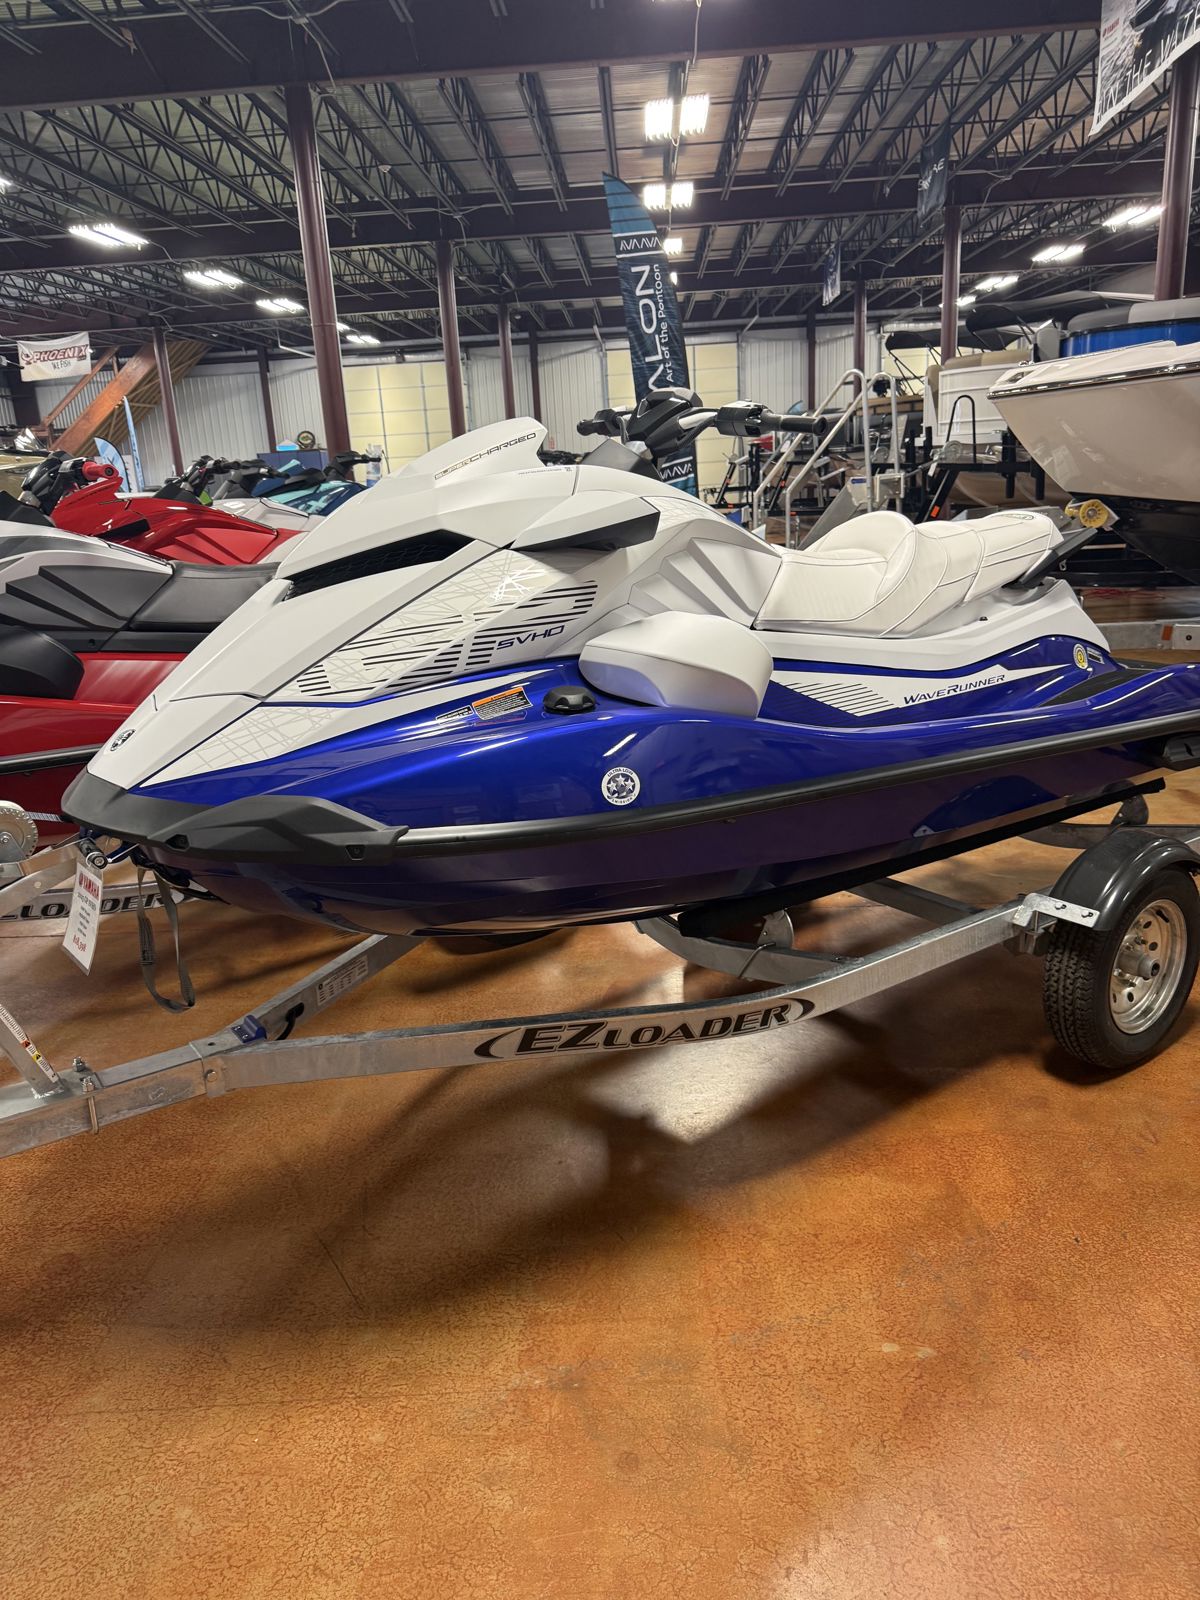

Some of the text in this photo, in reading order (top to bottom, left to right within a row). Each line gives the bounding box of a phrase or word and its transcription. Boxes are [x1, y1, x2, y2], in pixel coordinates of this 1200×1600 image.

[1126, 48, 1153, 97] THE
[654, 264, 674, 383] Art of the Pontoon
[33, 344, 89, 363] PHOENIX
[496, 624, 565, 651] SVHO
